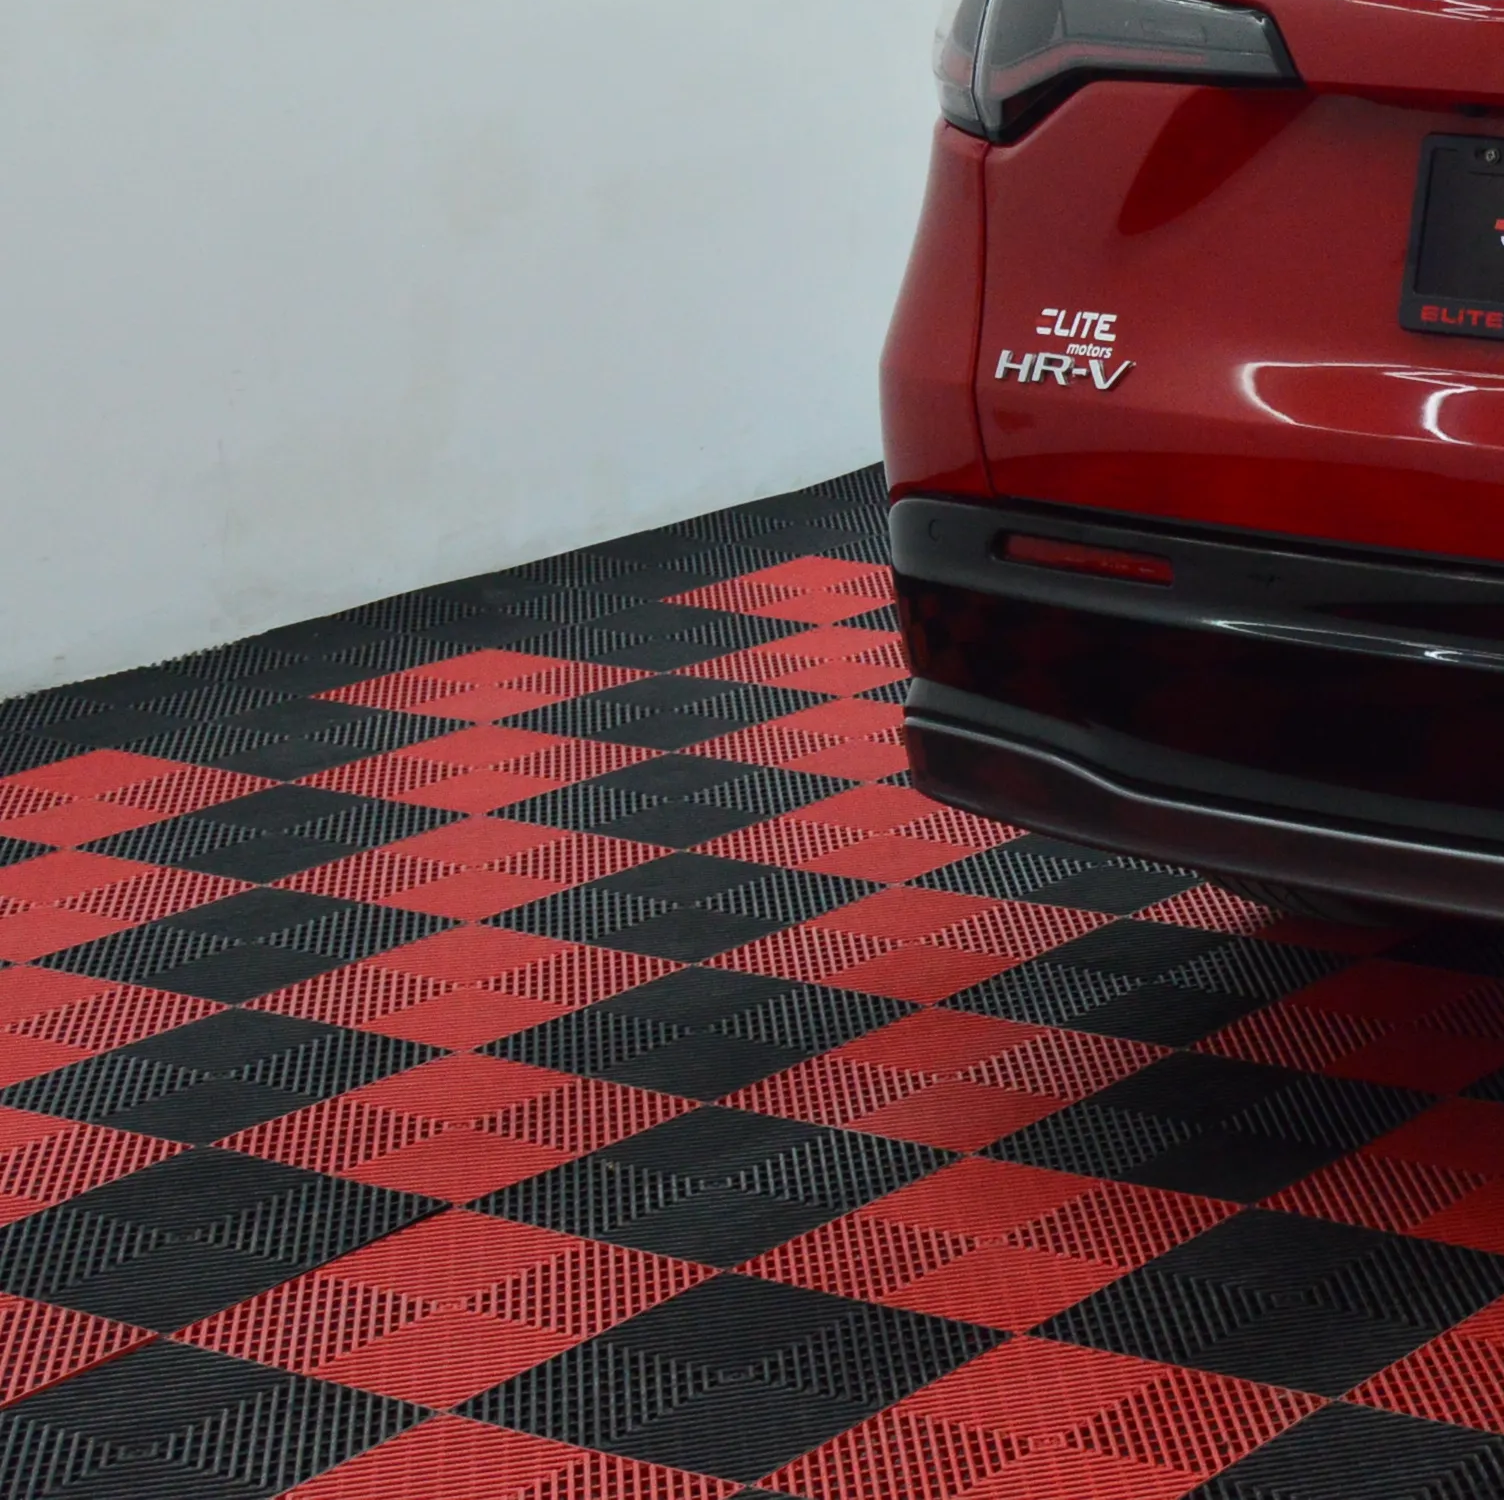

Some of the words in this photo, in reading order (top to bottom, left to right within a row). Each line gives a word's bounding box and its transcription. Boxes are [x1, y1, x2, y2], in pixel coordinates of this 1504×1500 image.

[1035, 308, 1118, 342] ELITE
[1065, 342, 1114, 360] motors
[994, 349, 1137, 391] HR-V
